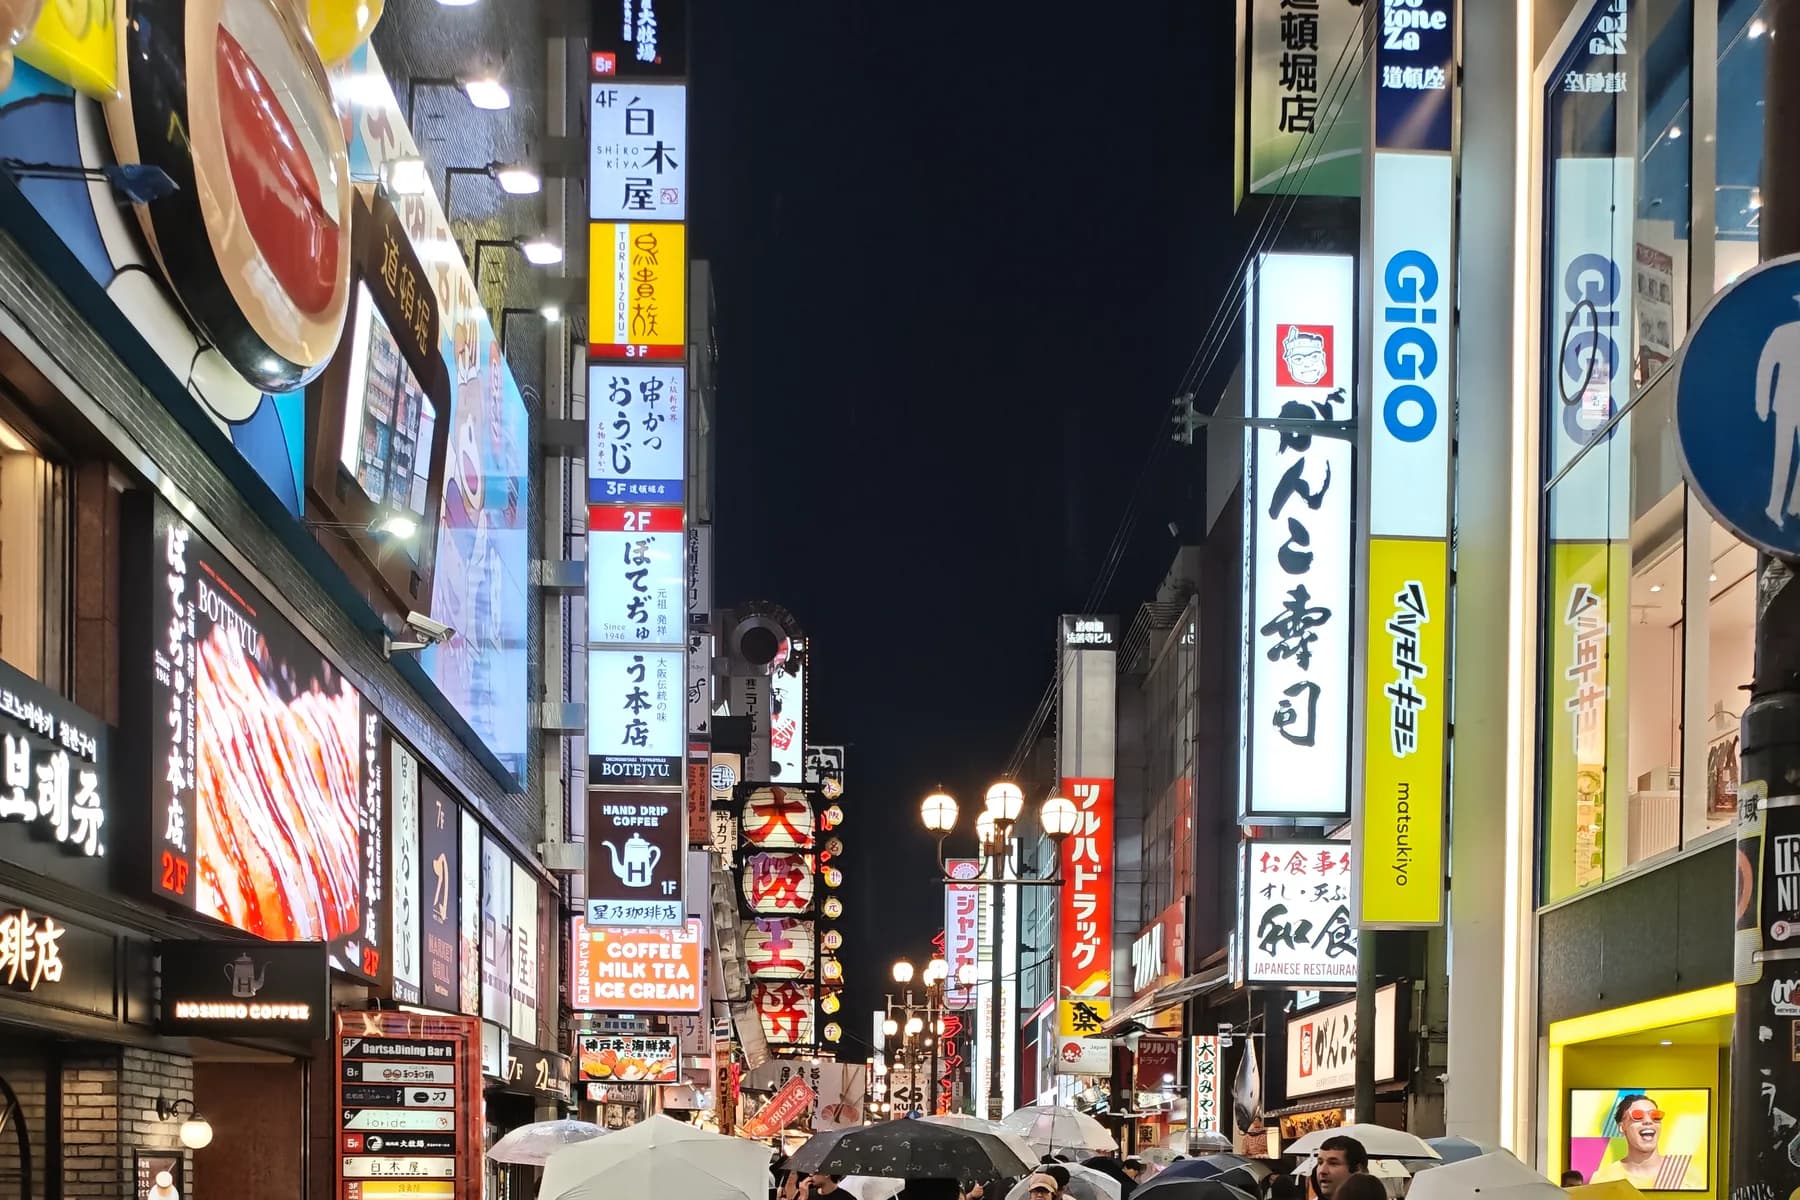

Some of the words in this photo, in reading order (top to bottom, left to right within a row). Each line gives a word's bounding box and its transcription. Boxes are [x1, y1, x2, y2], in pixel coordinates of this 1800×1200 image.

[1384, 28, 1420, 50] Za
[1382, 66, 1445, 89] 道頓座
[596, 91, 618, 108] 4F
[622, 97, 678, 210] 白木屋
[381, 223, 430, 356] 道頓堀
[626, 346, 648, 357] 3F
[1383, 250, 1438, 442] GiGO
[640, 376, 664, 450] 串かつ
[609, 376, 632, 474] おうじ
[624, 511, 651, 531] 2F
[624, 536, 655, 640] ぼてぢゅ
[1388, 583, 1427, 755] マツモトキヨシ
[622, 655, 652, 747] う本店
[603, 805, 636, 816] HAND
[640, 806, 668, 817] DRIP
[614, 816, 659, 827] COFFEE
[1396, 782, 1413, 887] matsukiyo
[161, 850, 189, 895] 2F
[1072, 784, 1101, 969] ツルハドラッグ
[661, 881, 677, 894] 1F
[593, 904, 677, 921] 星乃珈琲店
[1257, 903, 1358, 957] 和食
[607, 942, 683, 960] COFFEE
[598, 962, 646, 979] MILK
[653, 963, 690, 979] TEA
[1253, 962, 1301, 976] JAPANESE
[594, 983, 625, 999] ICE
[629, 983, 695, 1000] CREAM
[175, 1001, 248, 1020] HOSHINO
[249, 1003, 310, 1021] COFFEE
[1198, 1042, 1215, 1130] 大阪みやげ
